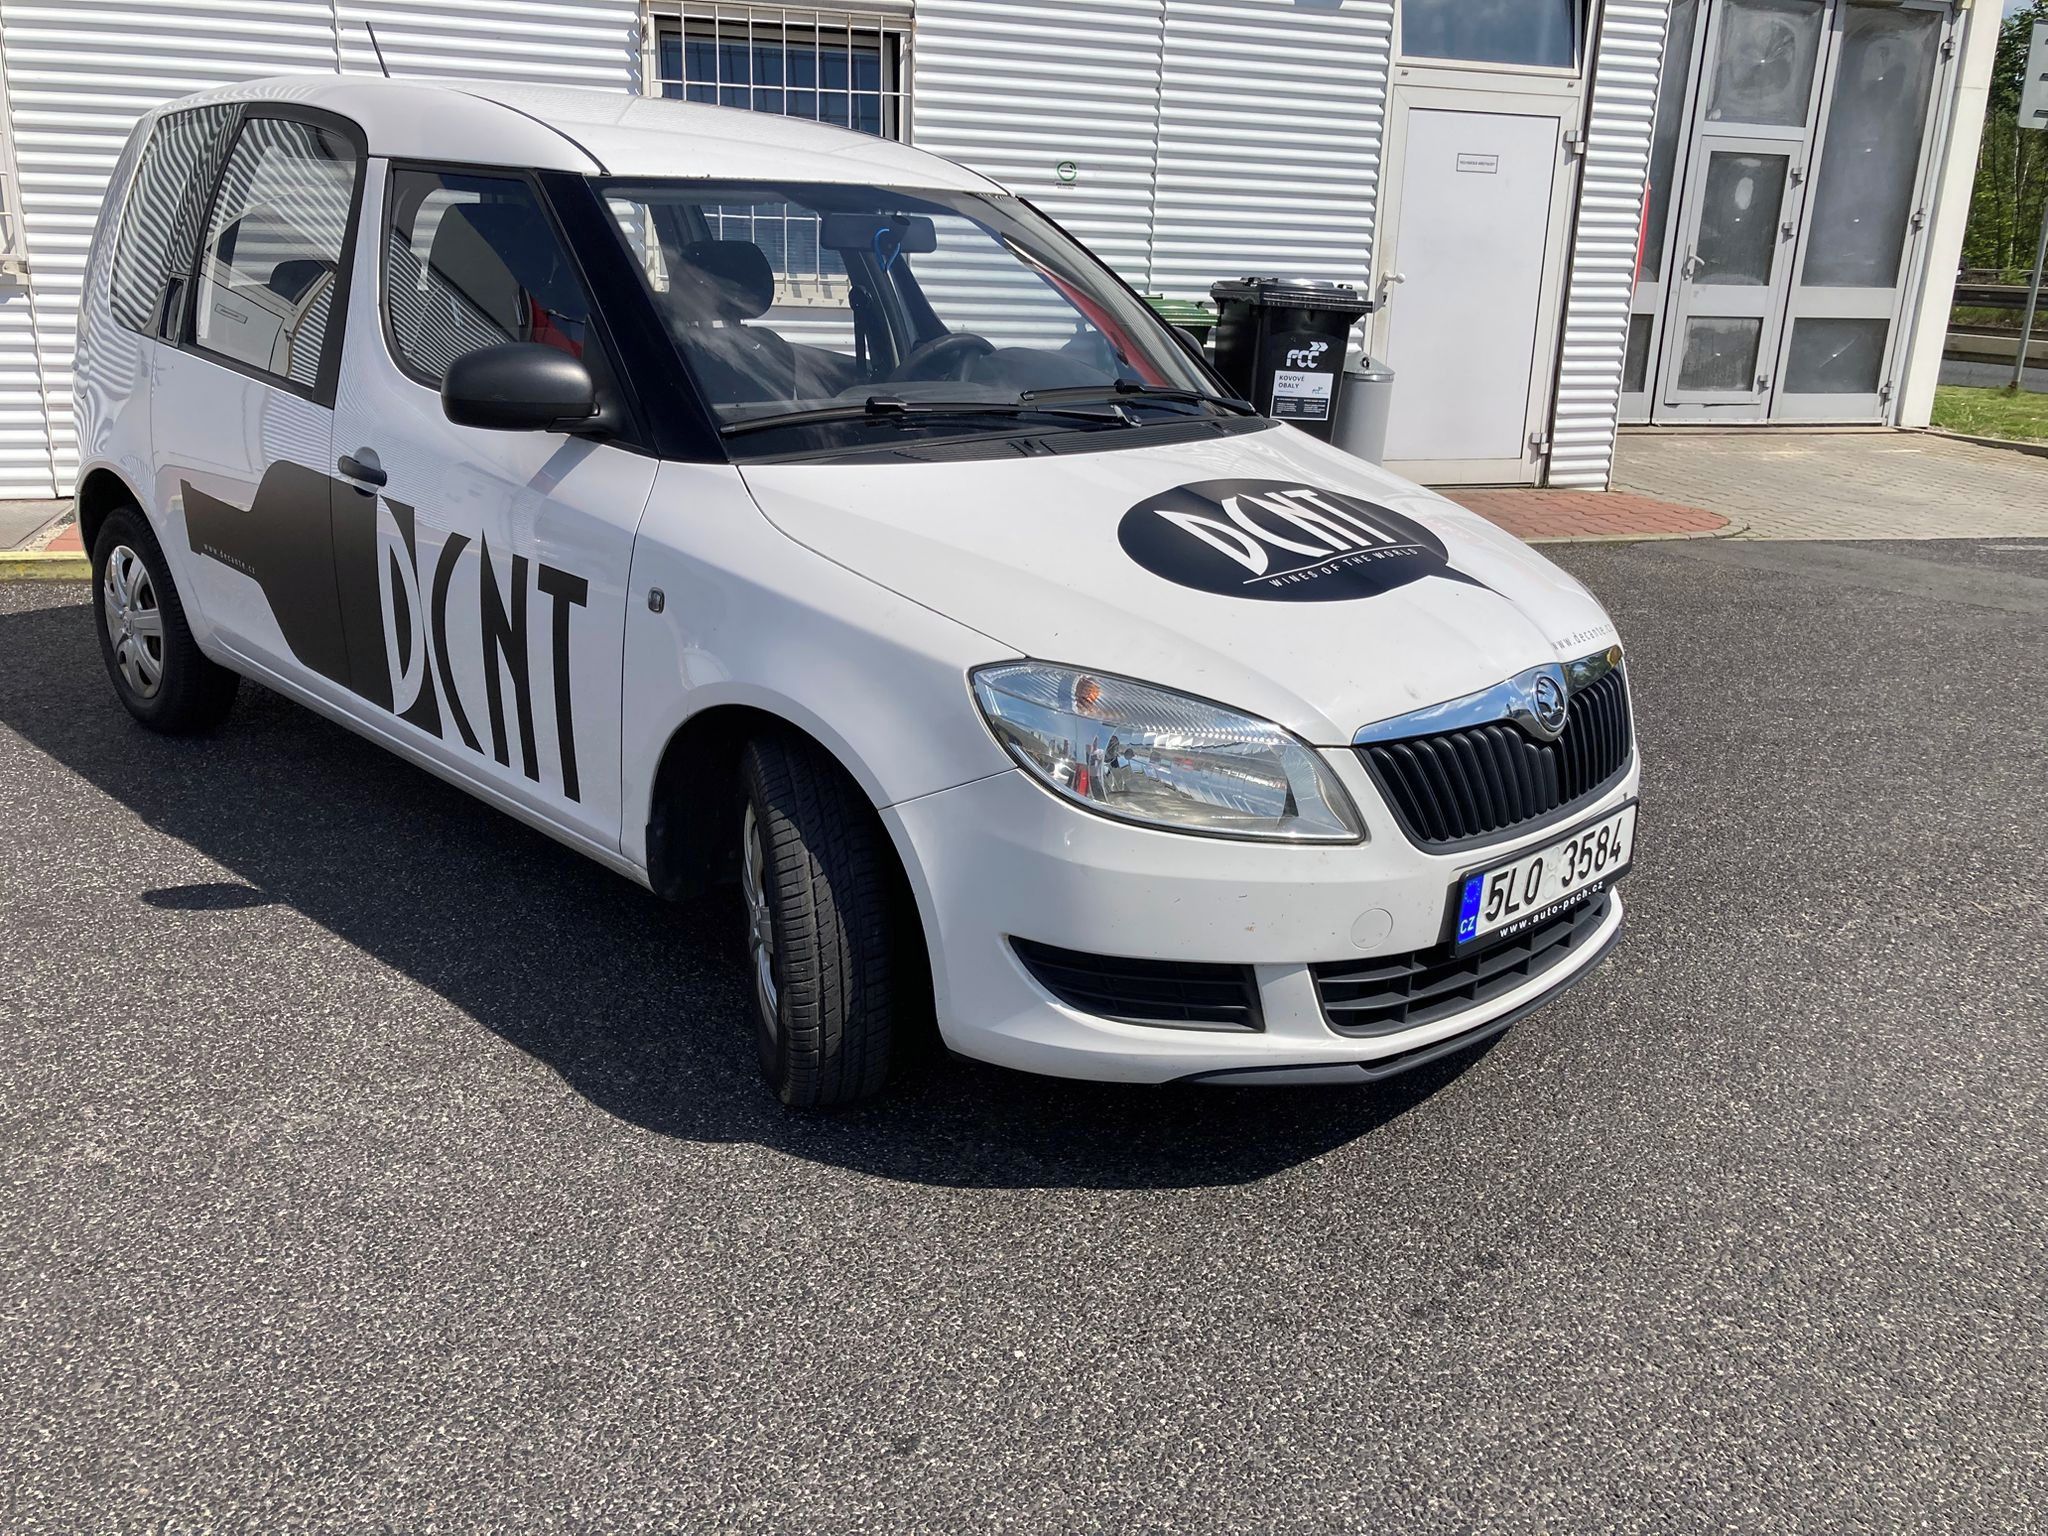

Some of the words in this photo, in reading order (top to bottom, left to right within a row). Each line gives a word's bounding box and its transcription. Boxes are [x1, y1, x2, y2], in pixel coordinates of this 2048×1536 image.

[1286, 350, 1320, 368] FCC
[1269, 570, 1318, 587] WINES
[1321, 563, 1340, 575] OF
[1342, 554, 1371, 567] THE
[1372, 547, 1418, 559] WORLD
[1561, 817, 1623, 887] 3584
[1460, 915, 1476, 934] CZ
[1500, 881, 1604, 938] www.auto-pech.cz
